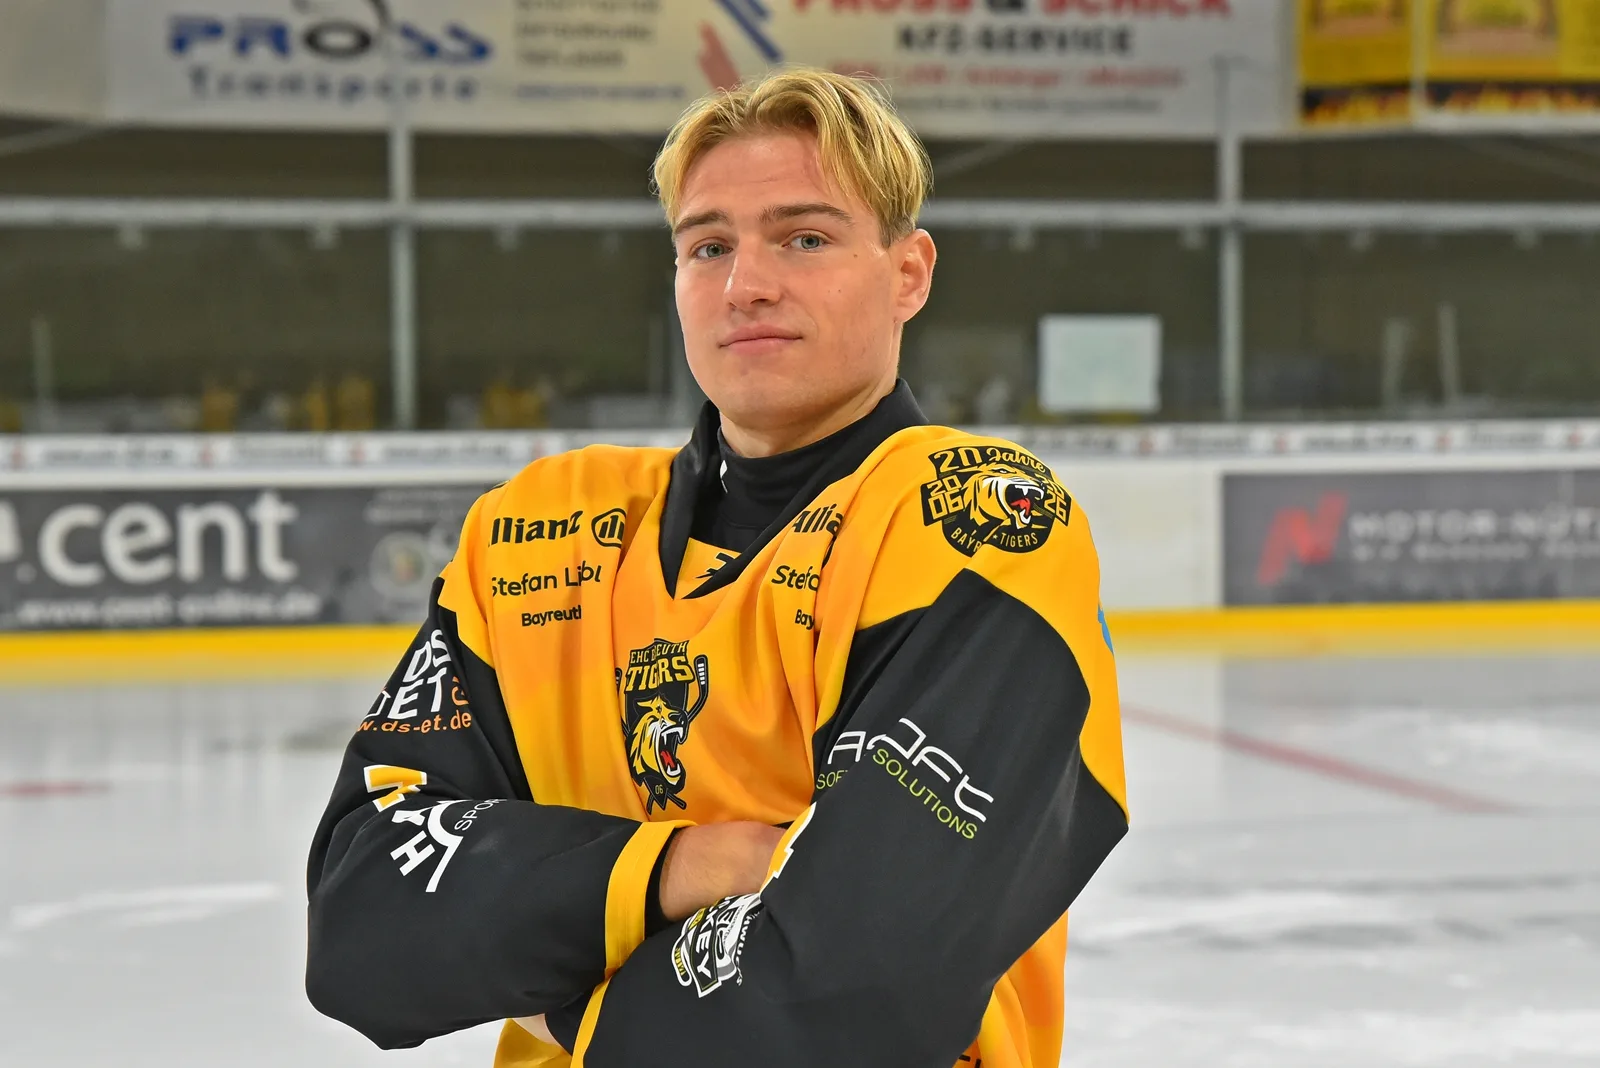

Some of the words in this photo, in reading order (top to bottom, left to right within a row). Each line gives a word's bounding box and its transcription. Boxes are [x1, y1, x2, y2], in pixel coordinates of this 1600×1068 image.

[986, 447, 1046, 473] Jahre
[793, 503, 844, 537] Allia
[928, 493, 965, 520] 06
[488, 510, 584, 546] llianz
[951, 527, 982, 553] BAYR
[1000, 532, 1038, 548] TIGERS
[564, 560, 602, 587] Libl
[771, 565, 820, 592] Stefa
[794, 608, 814, 630] Bay
[630, 650, 650, 664] EHC
[625, 655, 694, 692] TIGRS
[816, 769, 849, 790] SOF
[872, 748, 978, 840] SOLUTIONS
